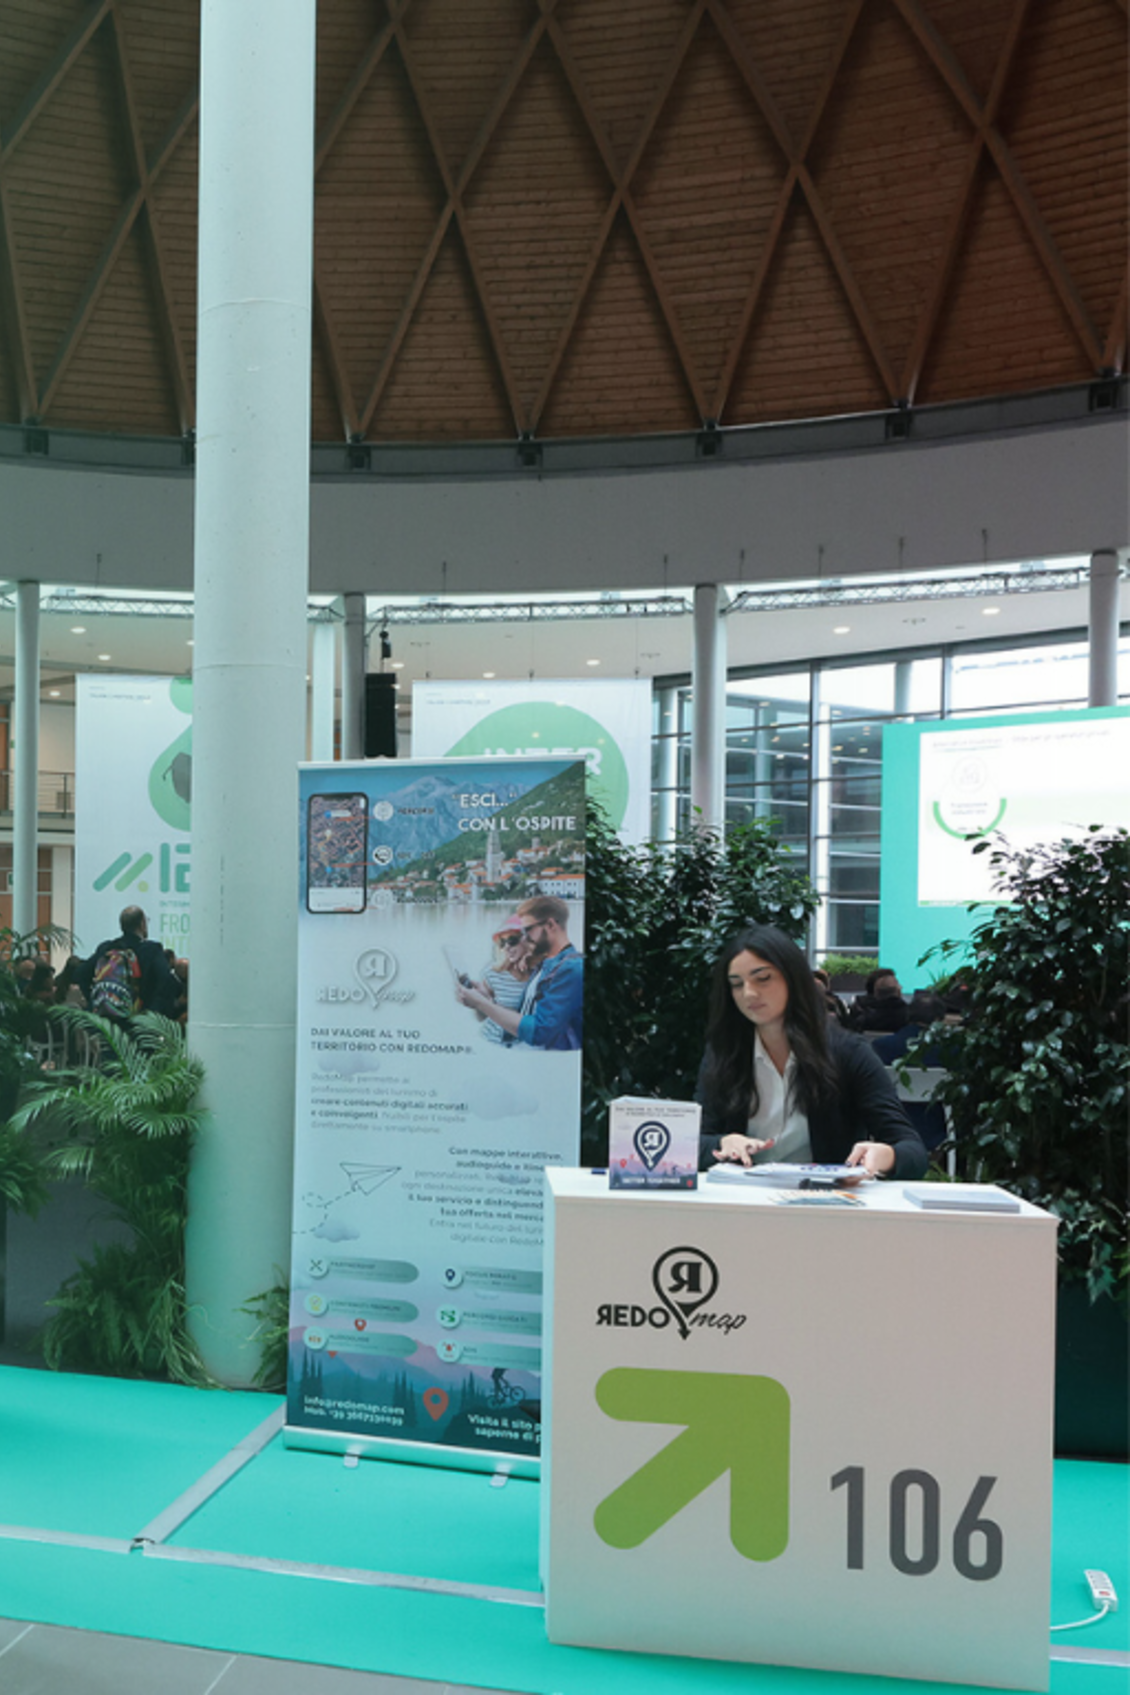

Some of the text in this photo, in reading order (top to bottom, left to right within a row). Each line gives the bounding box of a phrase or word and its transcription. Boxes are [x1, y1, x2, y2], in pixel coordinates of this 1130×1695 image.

[458, 817, 495, 832] CON
[331, 1028, 376, 1038] VALORE
[379, 1030, 393, 1039] AL
[397, 1030, 420, 1040] TUO
[311, 1041, 376, 1052] TERRITORIO
[379, 1043, 404, 1053] CON
[484, 1197, 544, 1210] distinguend
[688, 1311, 748, 1336] map
[829, 1465, 1004, 1582] 106
